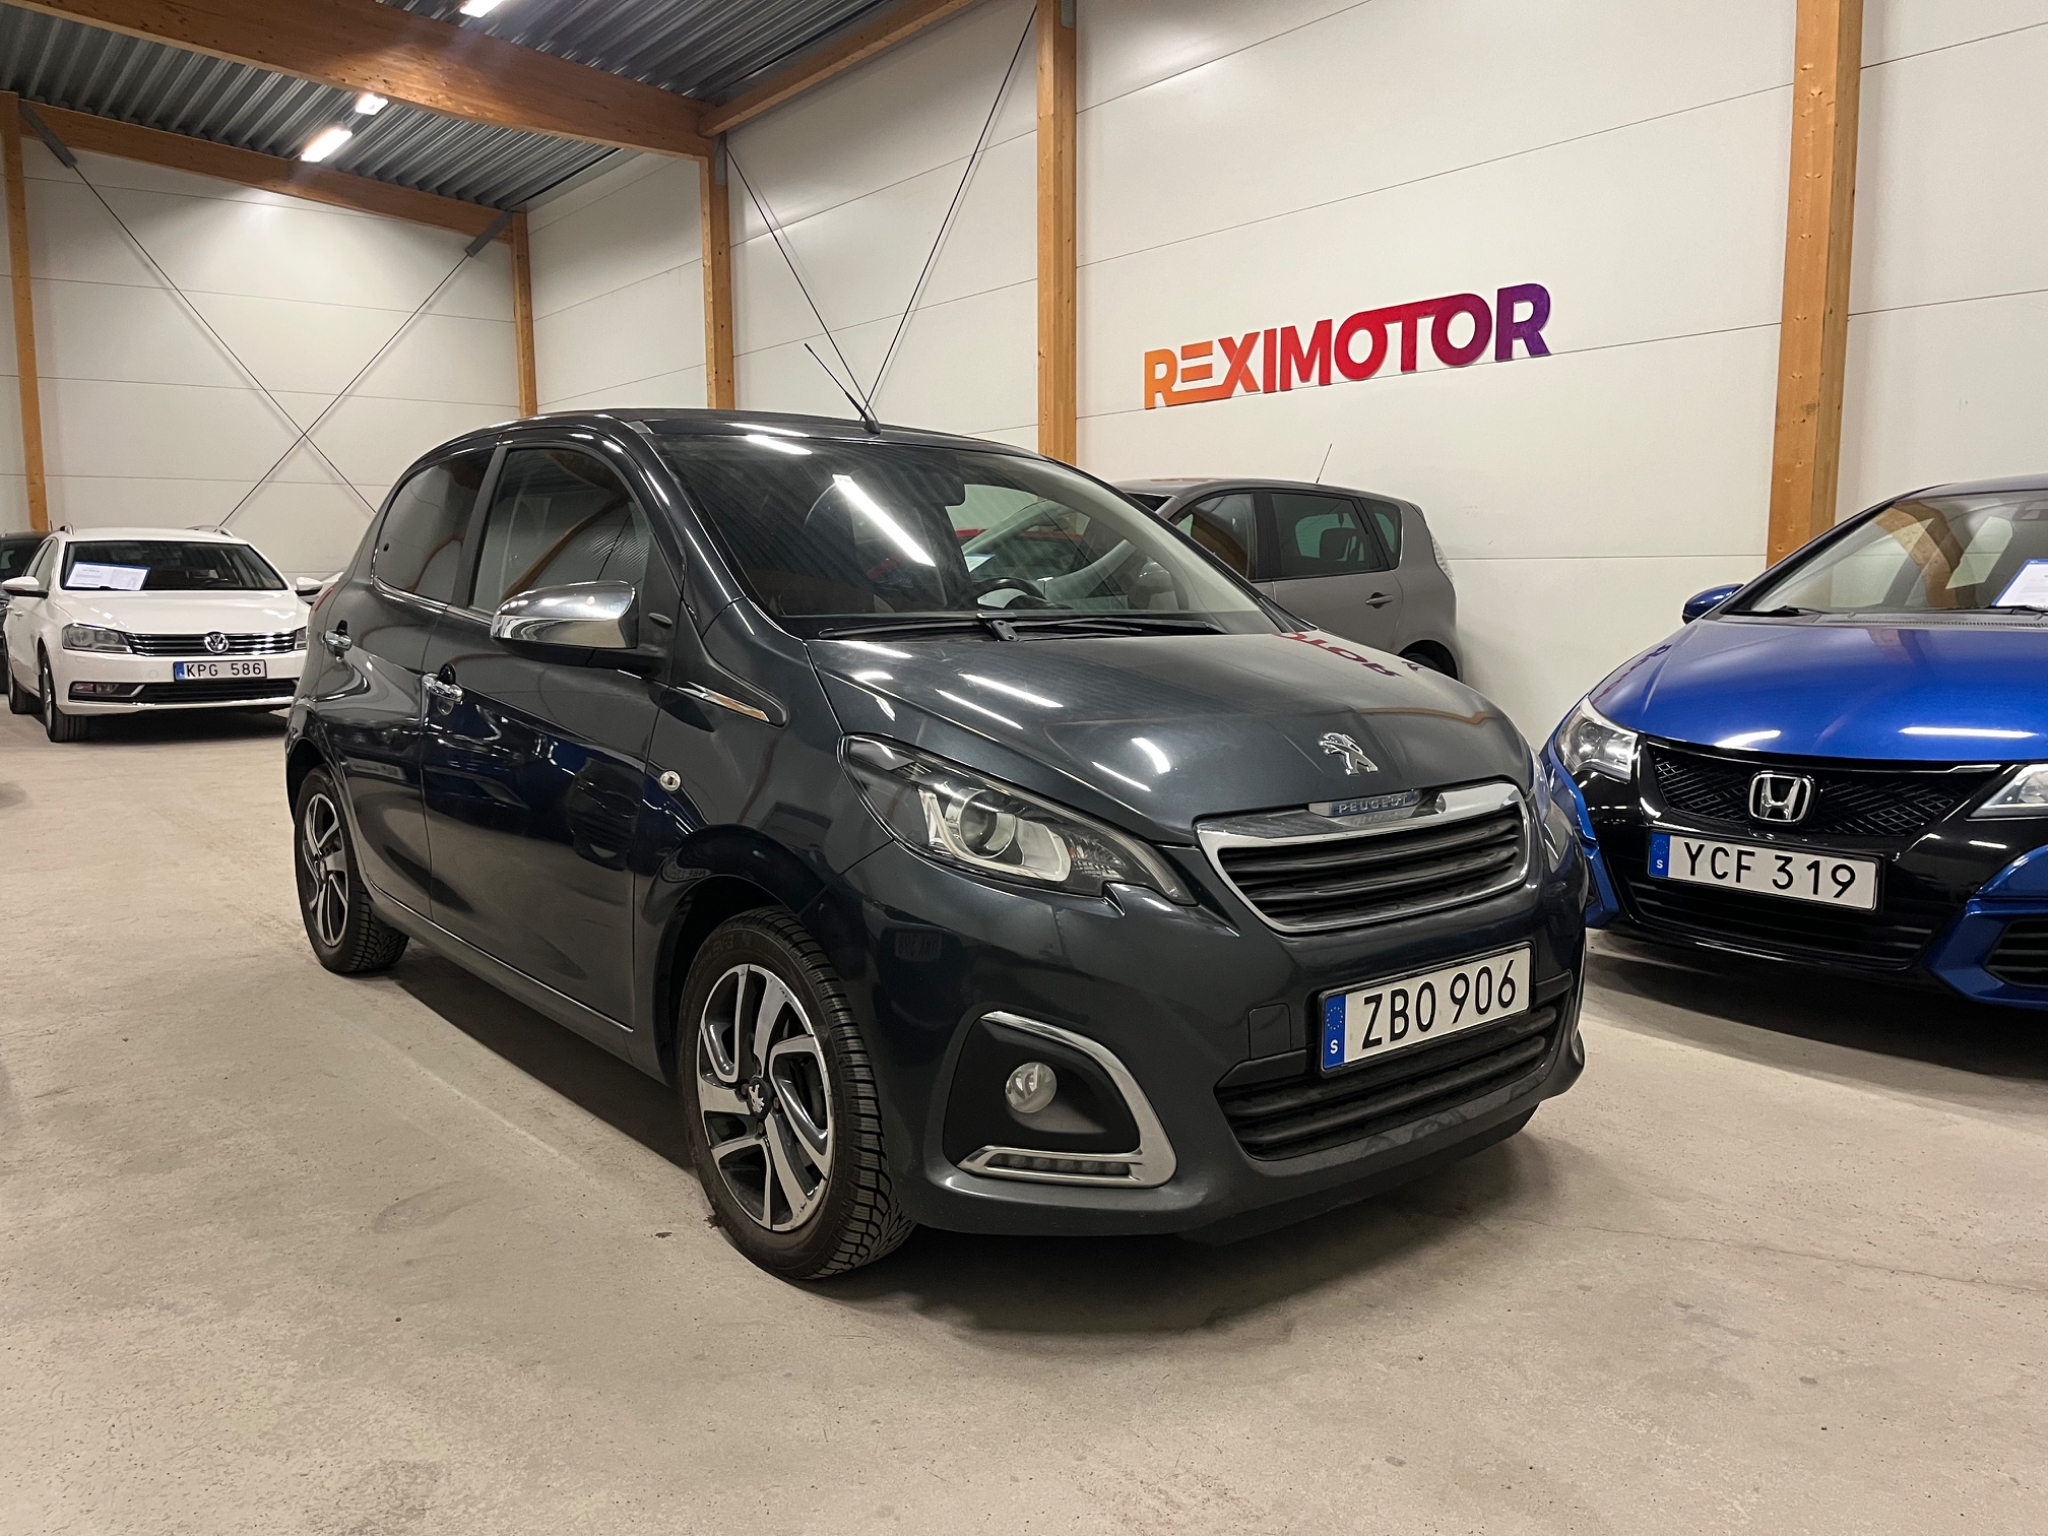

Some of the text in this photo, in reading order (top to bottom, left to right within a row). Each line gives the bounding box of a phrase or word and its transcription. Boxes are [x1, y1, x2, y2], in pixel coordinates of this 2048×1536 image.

[1145, 283, 1551, 410] REXIMOTOR
[186, 662, 262, 677] KPG 586
[1338, 794, 1409, 814] PEUGEOT
[1656, 859, 1664, 869] S
[1683, 841, 1856, 899] YCF 319
[1361, 959, 1516, 1050] ZBO 906
[1330, 1039, 1339, 1054] S
